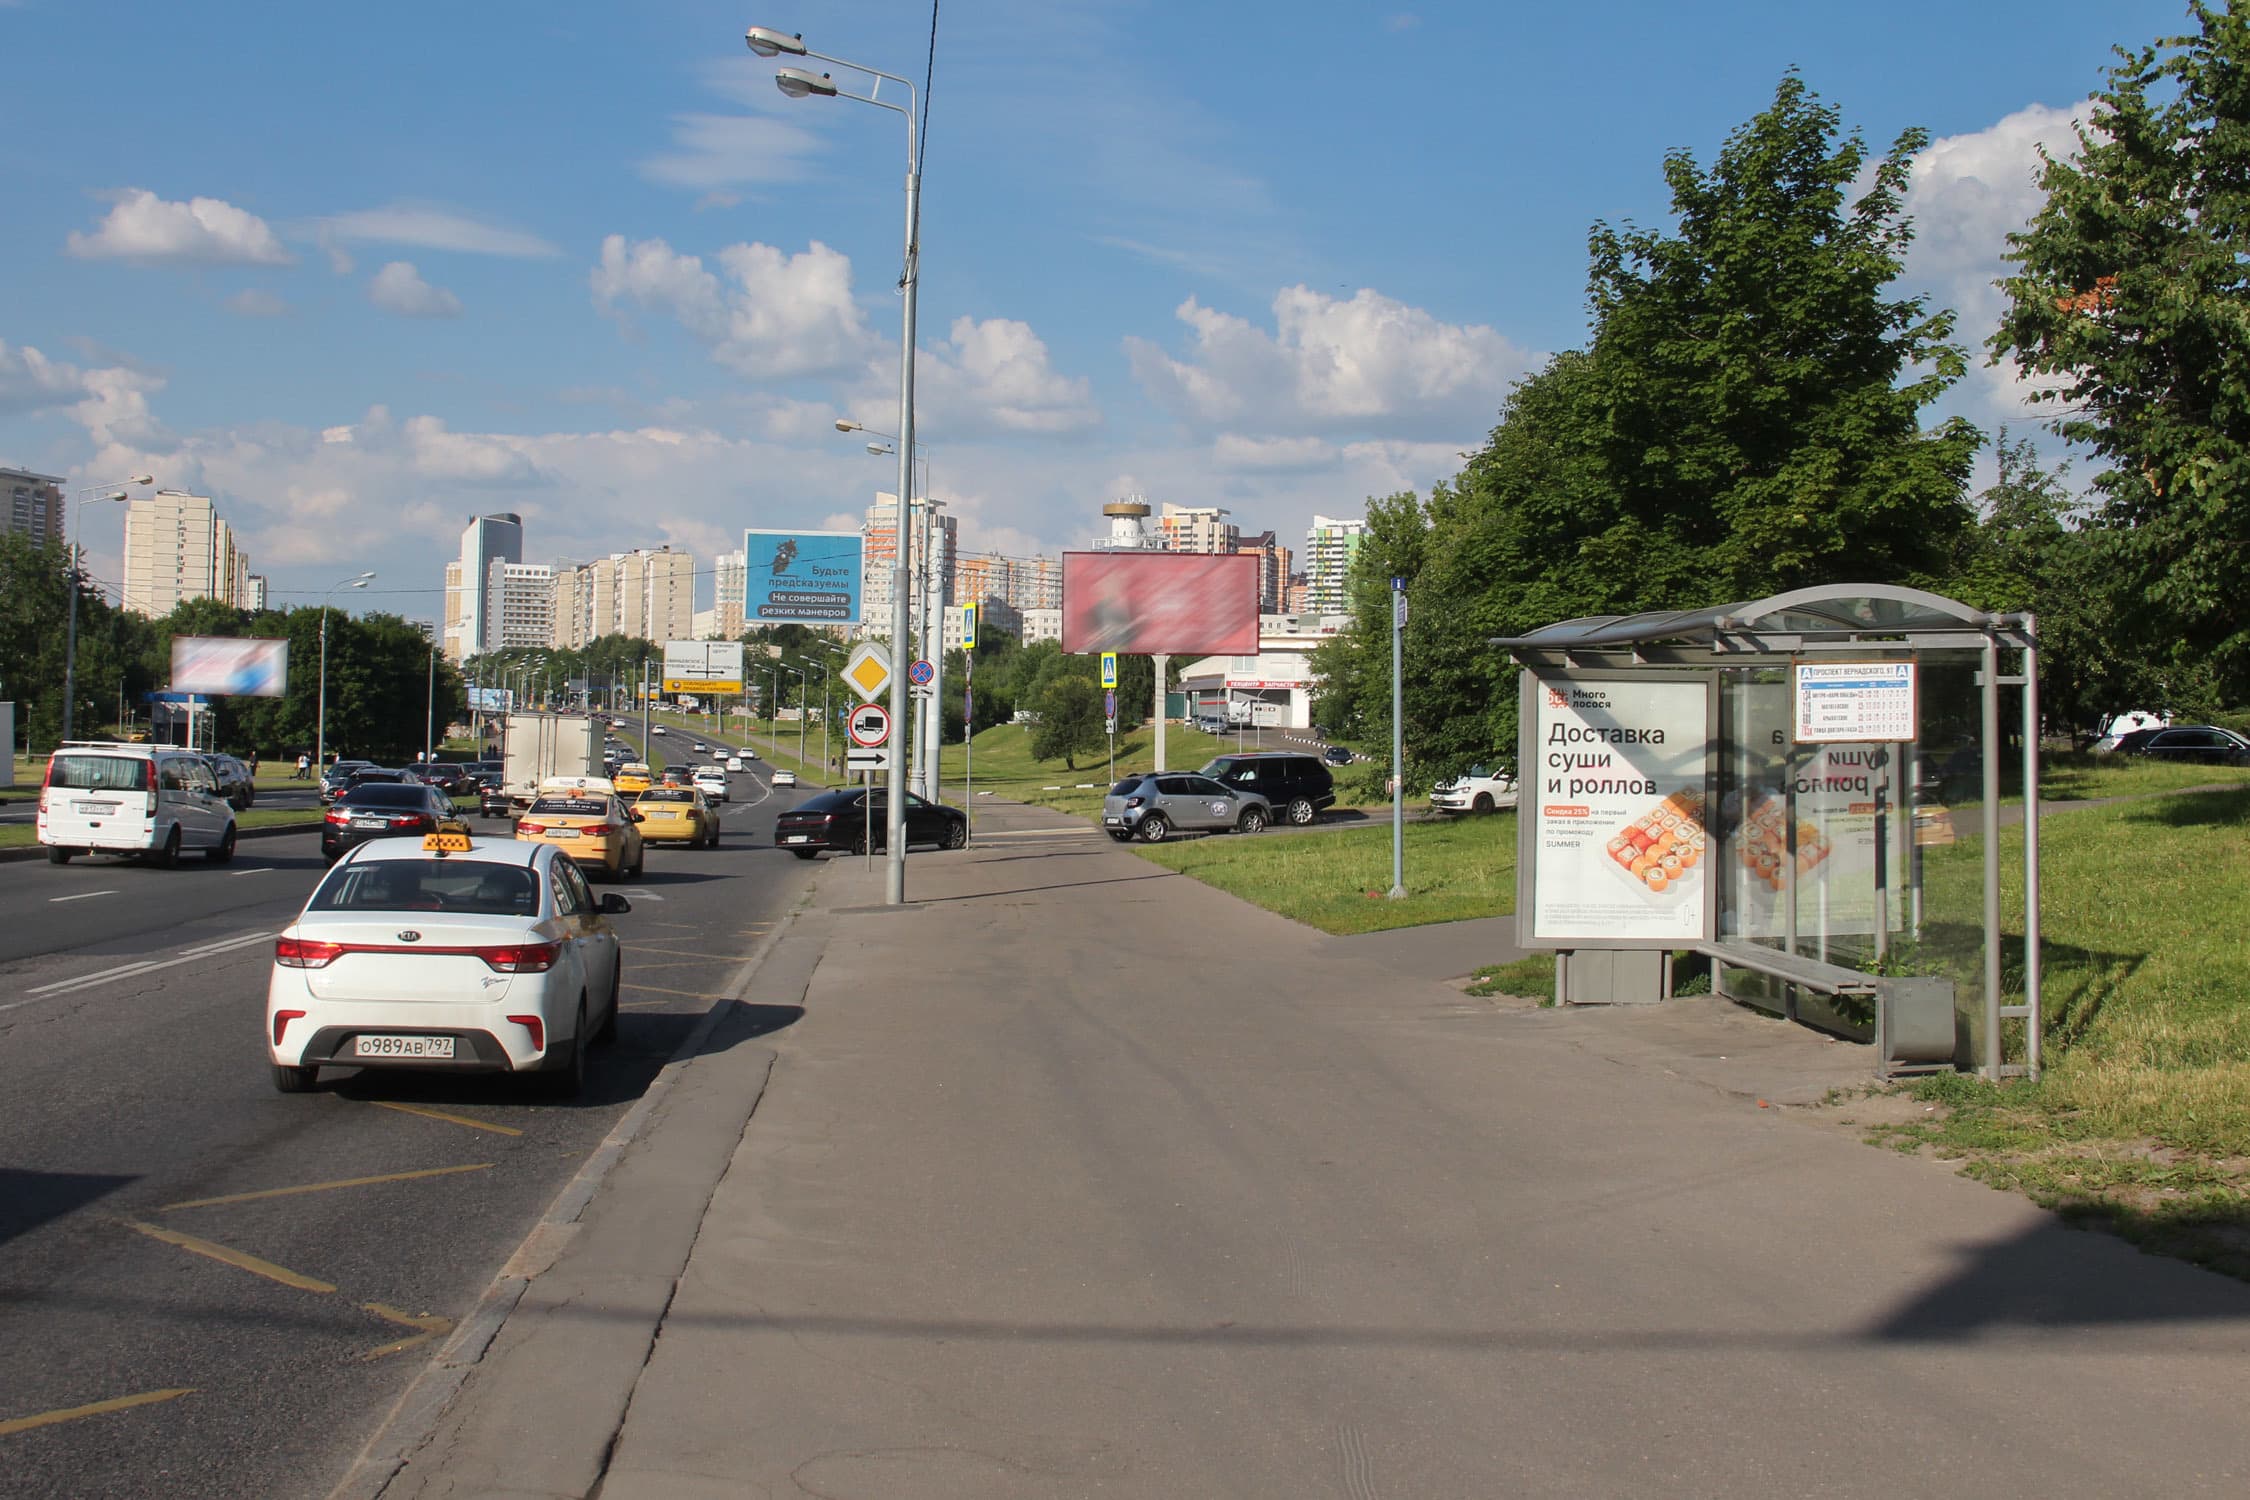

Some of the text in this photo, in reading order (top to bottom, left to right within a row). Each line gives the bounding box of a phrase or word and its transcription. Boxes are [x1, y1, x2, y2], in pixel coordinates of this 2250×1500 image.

[812, 565, 849, 577] Будьте
[768, 579, 849, 589] предсказуемы
[772, 593, 847, 603] Не совершайте
[761, 607, 846, 618] резких маневров
[1814, 668, 1842, 676] ПРОСПЕКТ
[1572, 689, 1606, 699] Много
[1572, 701, 1611, 709] лосося
[1548, 723, 1665, 746] Доставка
[1548, 752, 1611, 773] суши
[1548, 778, 1657, 799] и роллов
[1546, 807, 1573, 816] Скидка
[1573, 807, 1588, 815] 25%
[1600, 808, 1627, 816] первый
[1556, 829, 1594, 837] промокоду
[1546, 840, 1581, 848] SUMMER
[400, 931, 419, 941] KIA
[361, 1038, 450, 1054] О989АВ 797
